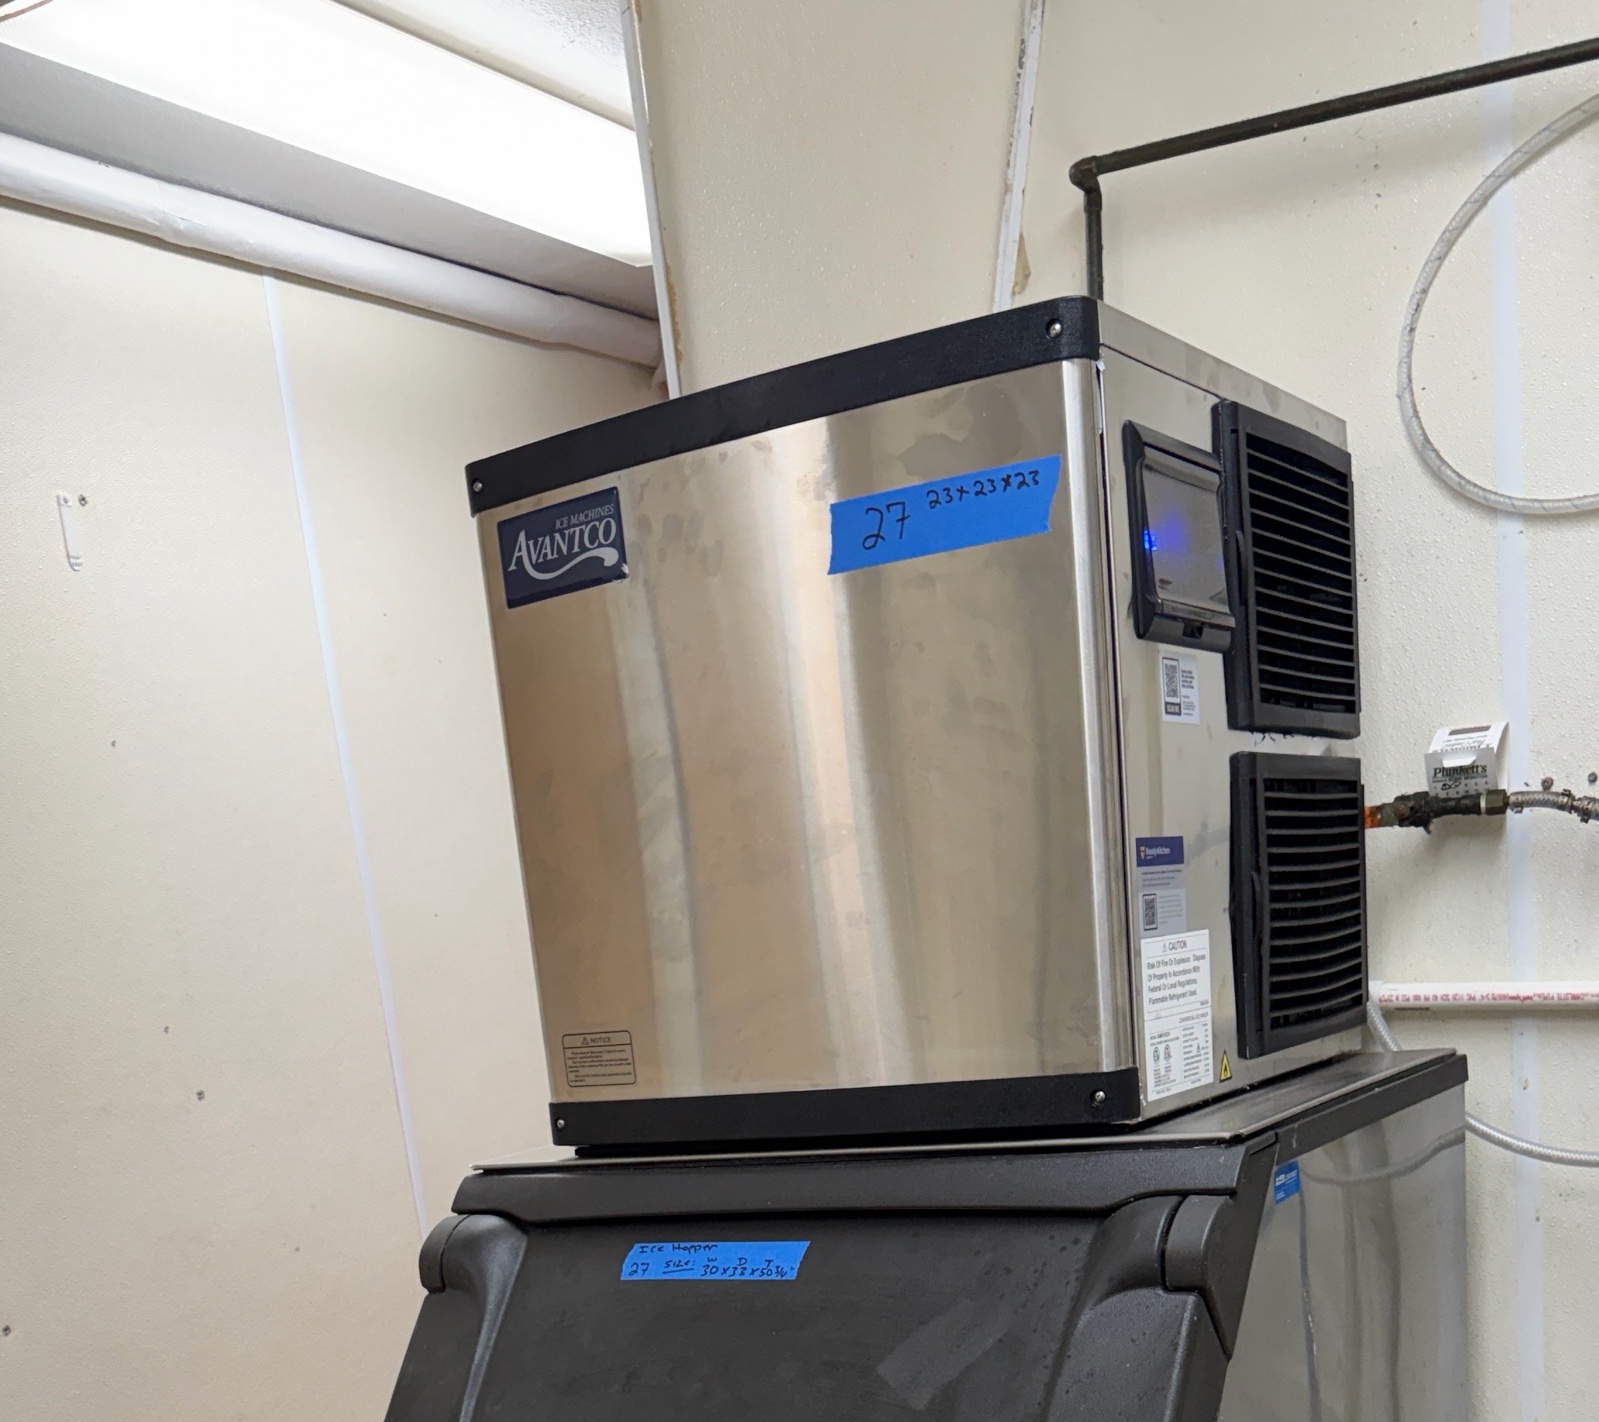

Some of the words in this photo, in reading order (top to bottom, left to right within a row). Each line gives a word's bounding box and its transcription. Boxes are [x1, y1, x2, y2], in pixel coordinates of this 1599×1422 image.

[555, 518, 569, 530] ICE
[570, 505, 614, 526] MACHINES
[862, 501, 911, 550] 27
[508, 518, 617, 573] AVANTCO
[1433, 764, 1487, 777] Plunkett's
[1169, 940, 1187, 951] CAUTION
[672, 1244, 718, 1258] Hopper
[737, 1257, 747, 1266] D
[765, 1260, 774, 1268] T
[629, 1263, 649, 1276] 27
